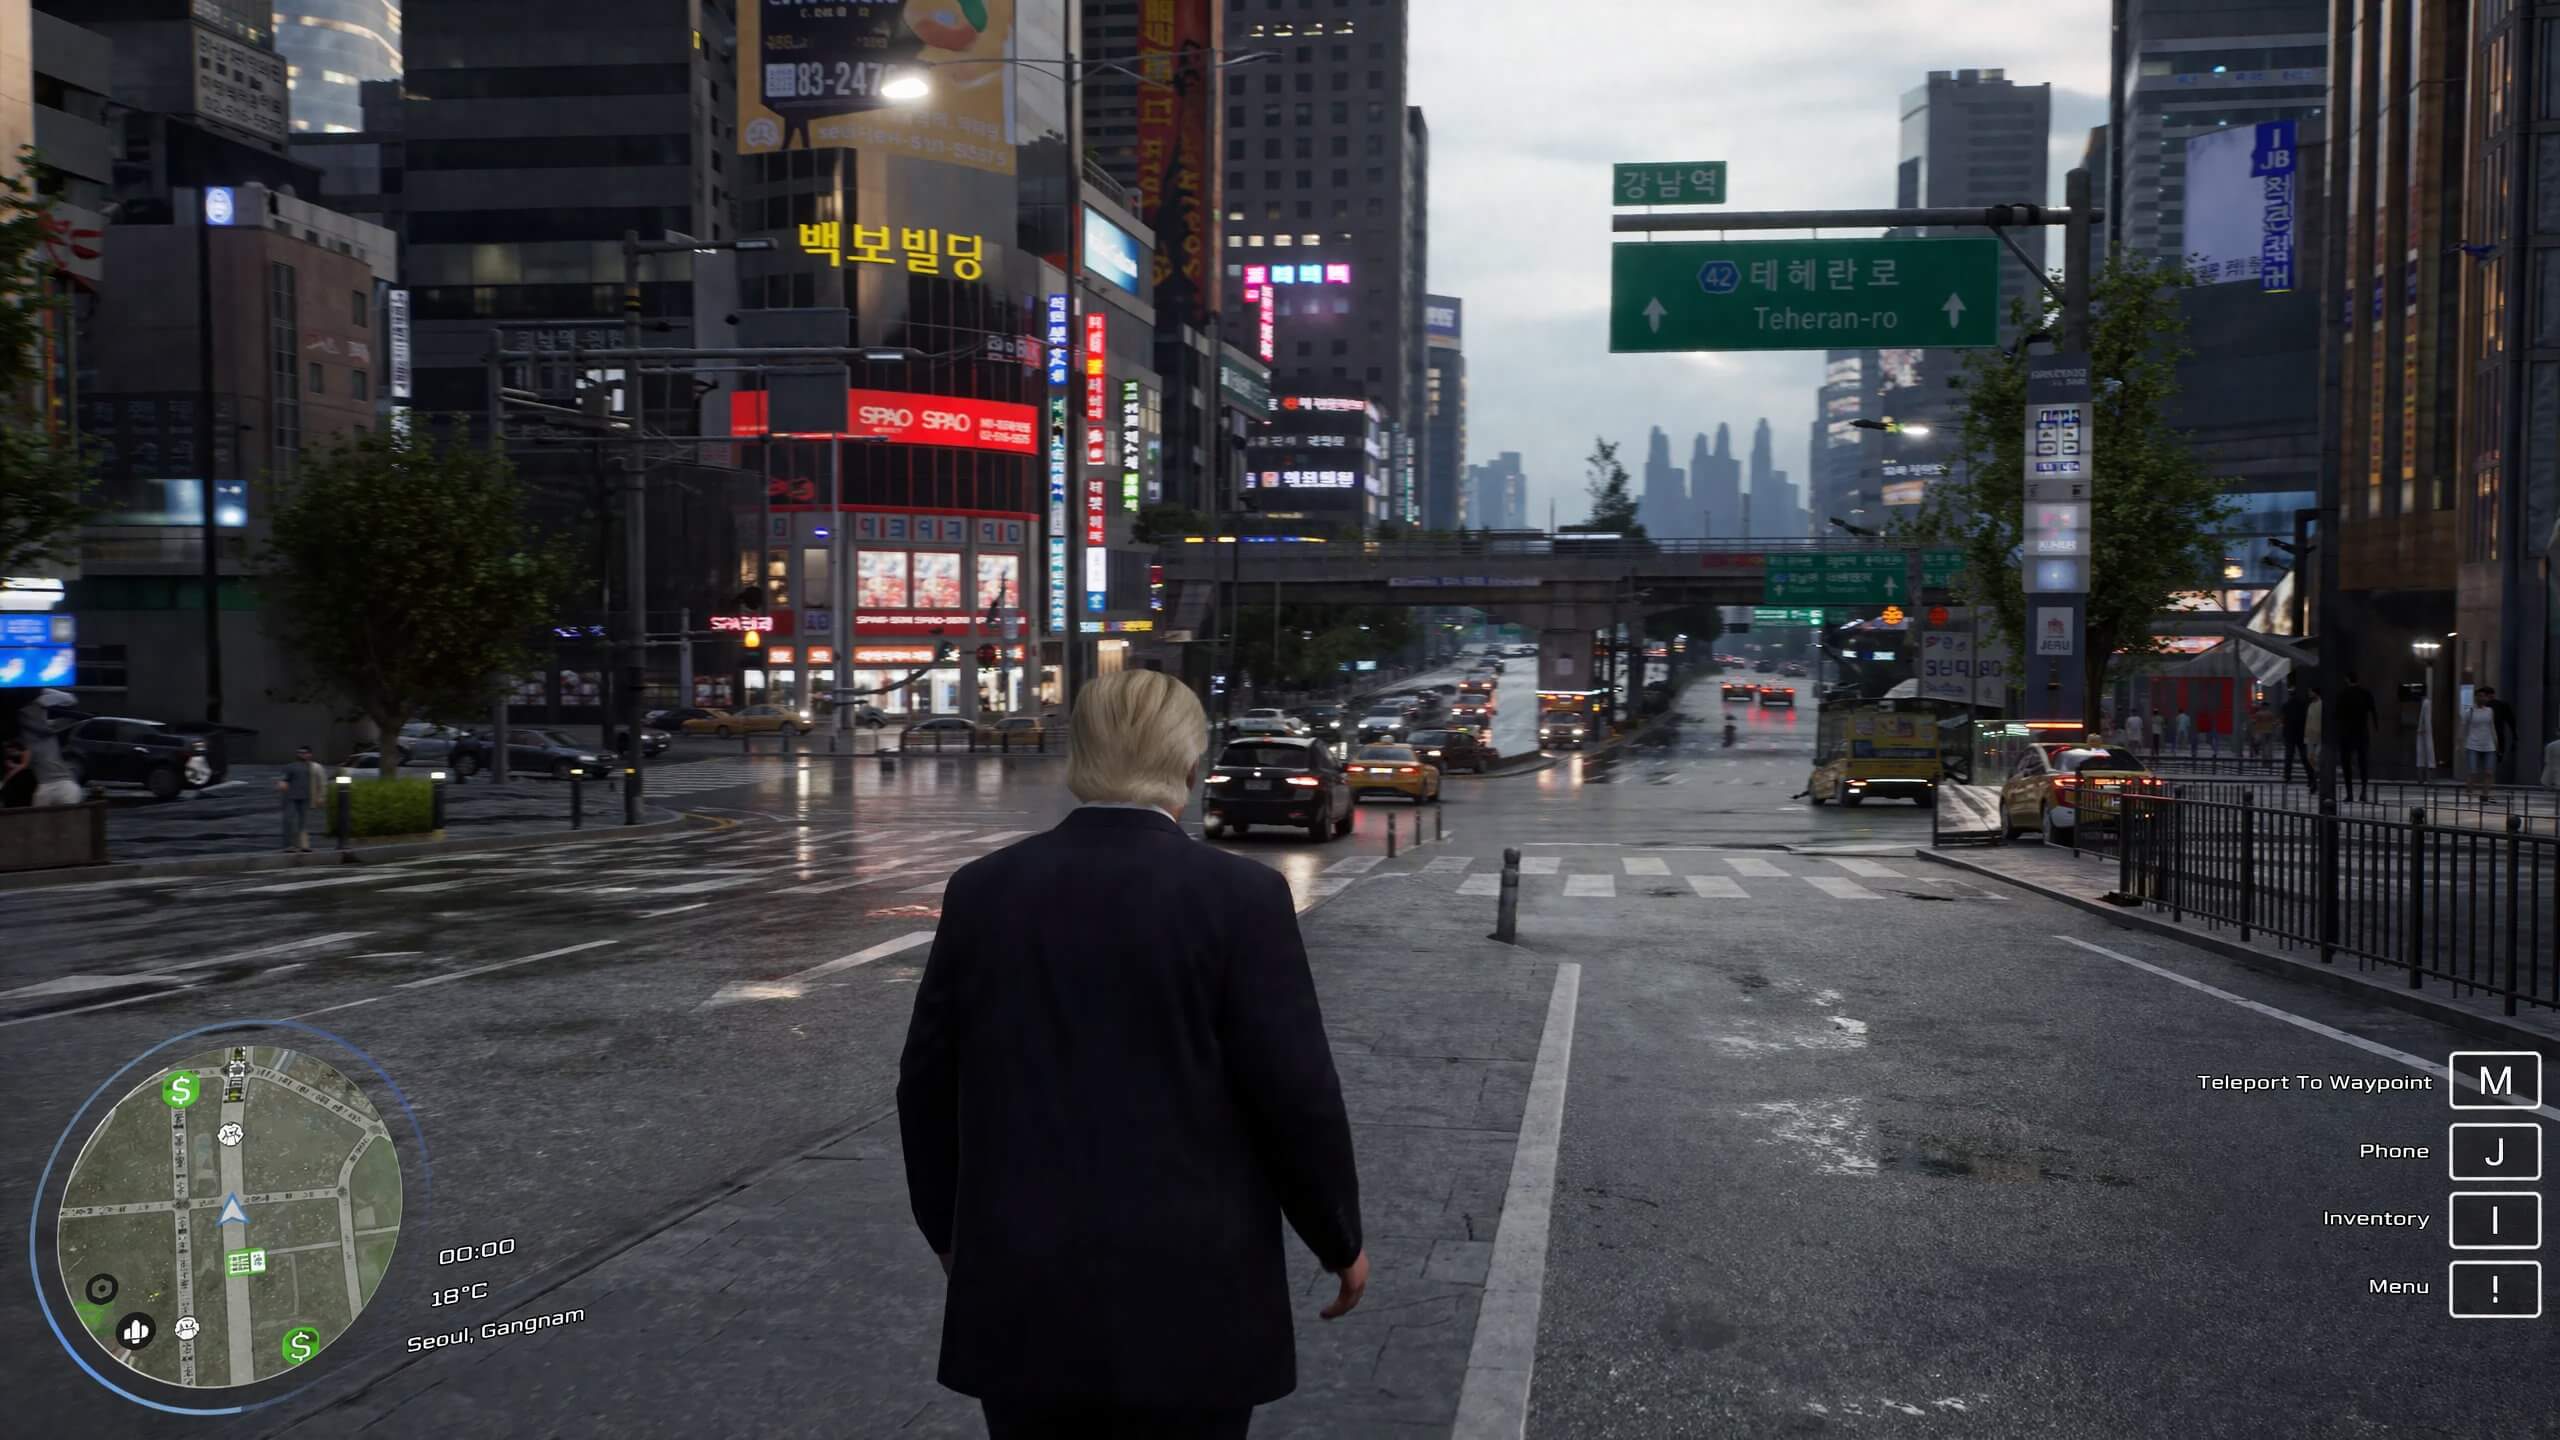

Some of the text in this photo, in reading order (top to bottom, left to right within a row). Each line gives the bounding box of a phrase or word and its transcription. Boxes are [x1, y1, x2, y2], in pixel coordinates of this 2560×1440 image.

[1621, 169, 1717, 199] 강남역
[798, 220, 983, 281] 백보빌딩
[1706, 258, 1899, 291] 42 테헤란로
[1753, 306, 1898, 330] Teheran-ro
[859, 406, 914, 427] SPAO
[921, 410, 972, 432] SPAO
